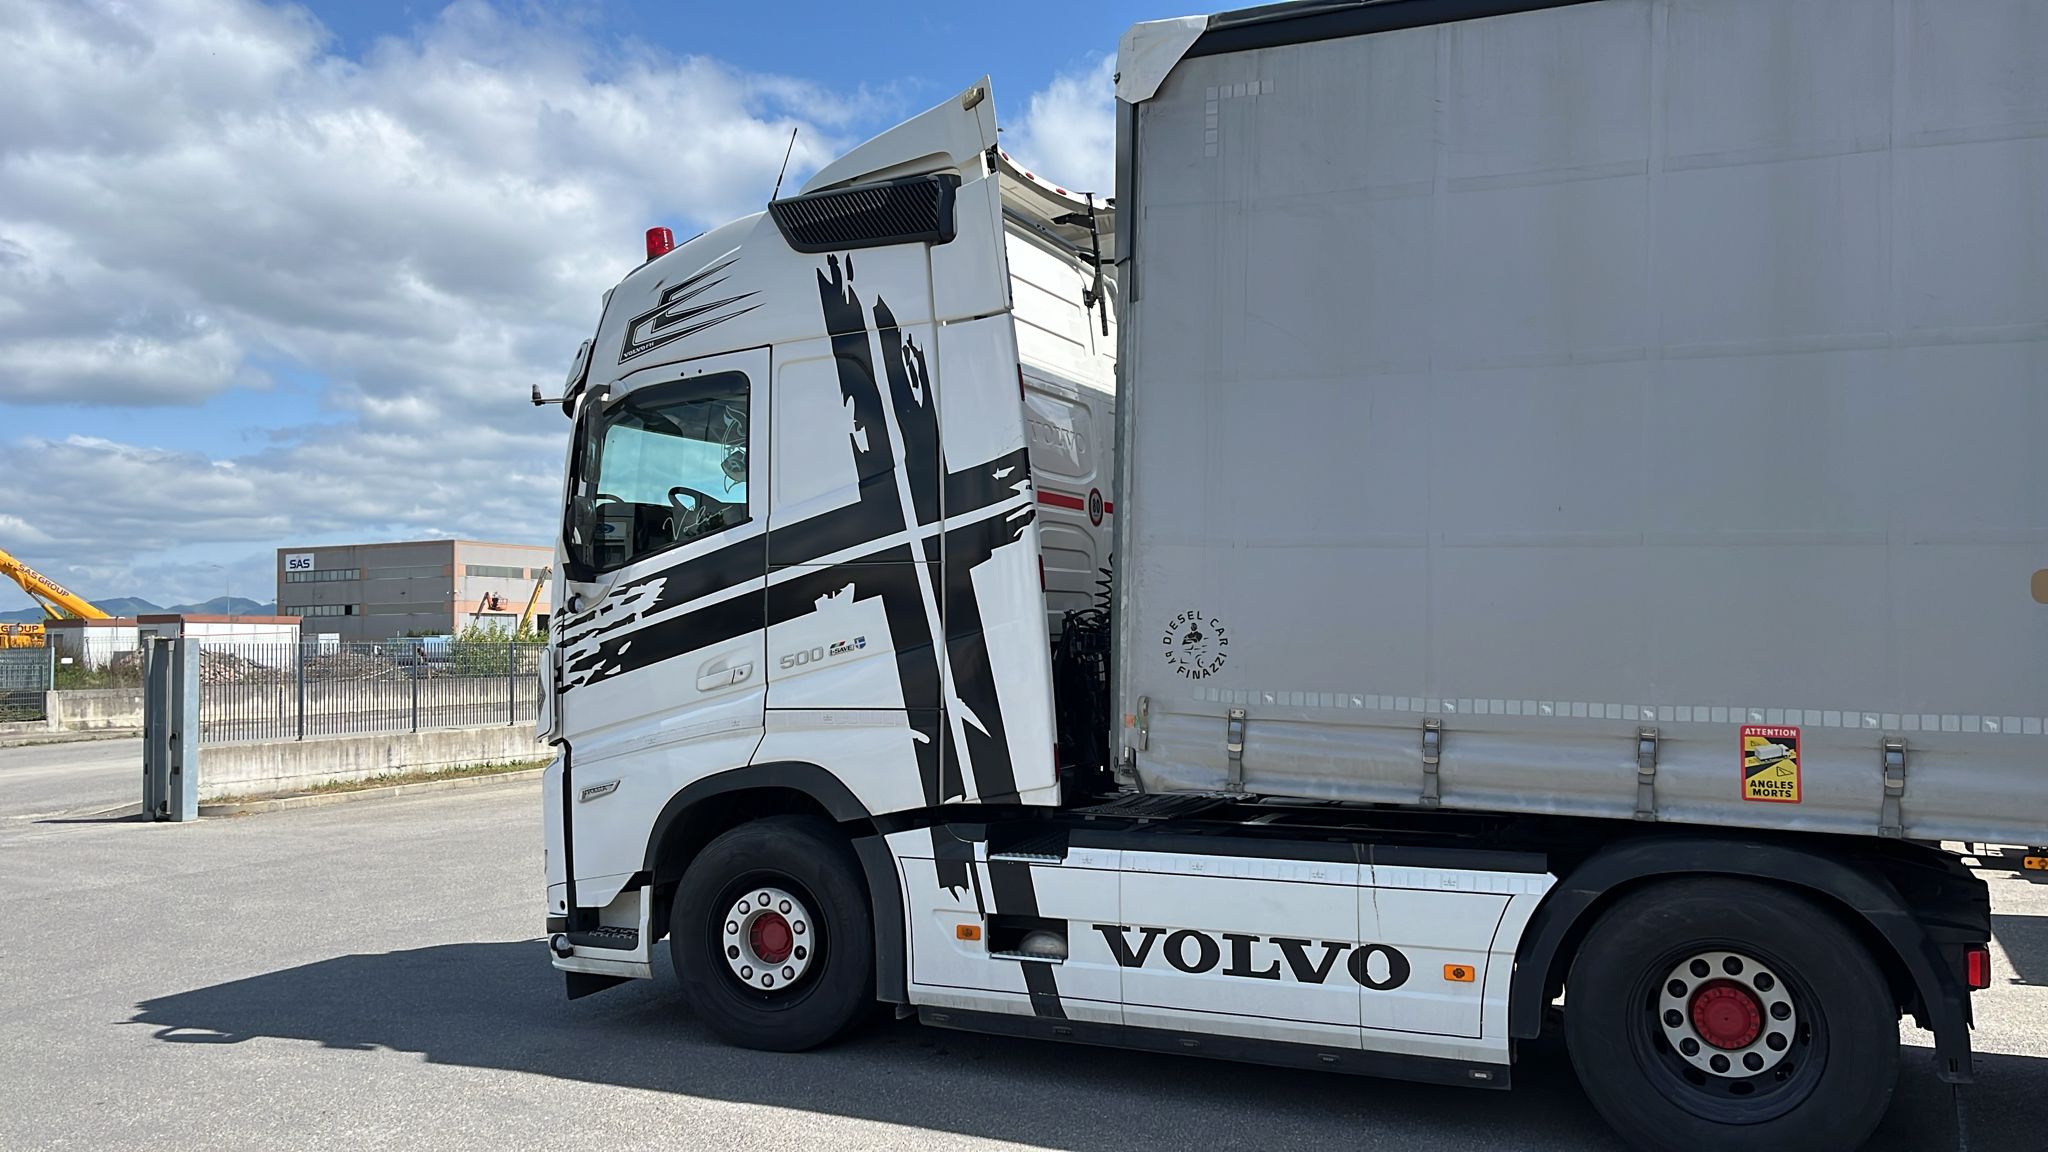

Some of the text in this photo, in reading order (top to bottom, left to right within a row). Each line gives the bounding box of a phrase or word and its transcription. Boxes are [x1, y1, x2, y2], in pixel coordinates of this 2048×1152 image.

[623, 341, 655, 358] VOLVO FH
[1026, 418, 1086, 455] VOLVO
[289, 558, 310, 569] SAS
[18, 563, 70, 597] SAS GROUP
[1, 625, 39, 633] GOUP
[1162, 610, 1229, 647] DIESEL CAR
[779, 646, 824, 670] 500
[1165, 650, 1227, 680] by FINAZZI
[1745, 728, 1796, 737] ATTENTION
[1750, 780, 1793, 789] ANGLES
[1753, 788, 1791, 797] MORTS
[1092, 923, 1411, 991] VOLVO
